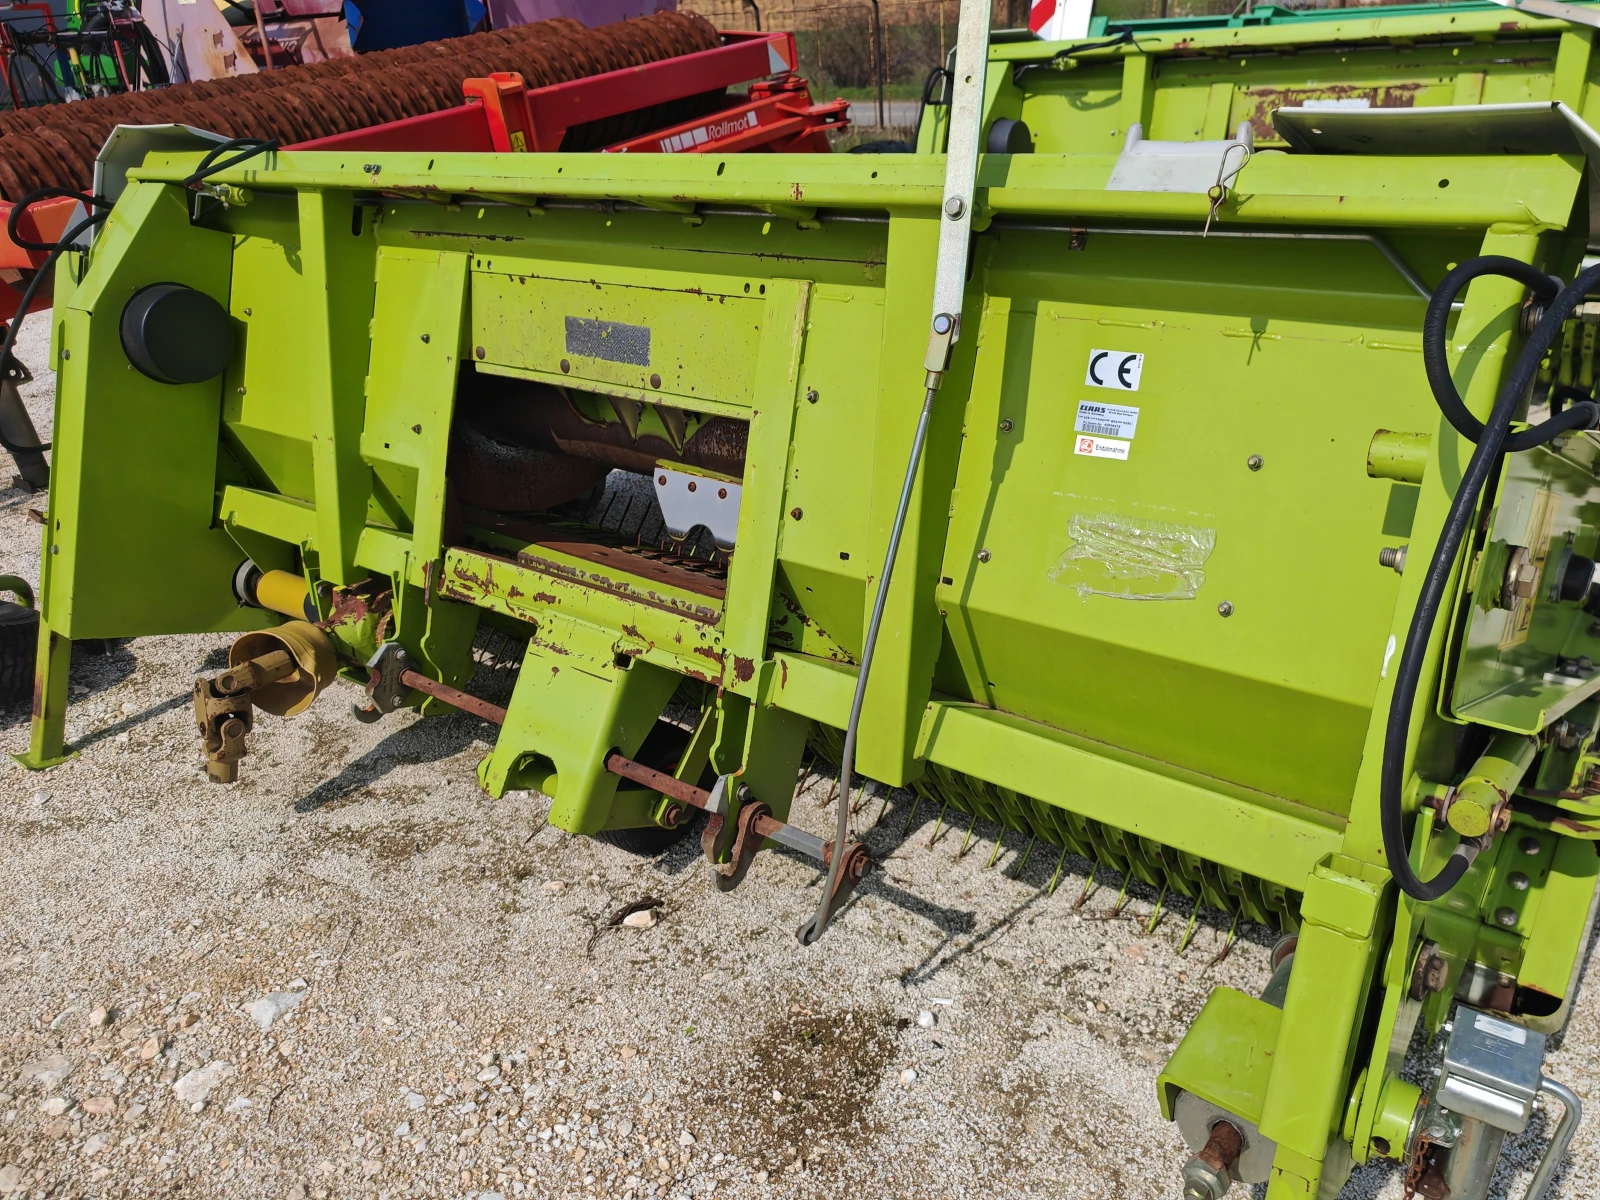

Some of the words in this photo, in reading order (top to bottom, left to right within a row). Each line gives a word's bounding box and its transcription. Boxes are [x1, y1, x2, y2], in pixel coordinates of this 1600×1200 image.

[708, 116, 748, 140] Rollmot
[1079, 404, 1106, 413] CLAAS
[1095, 444, 1126, 454] Endabnahme
